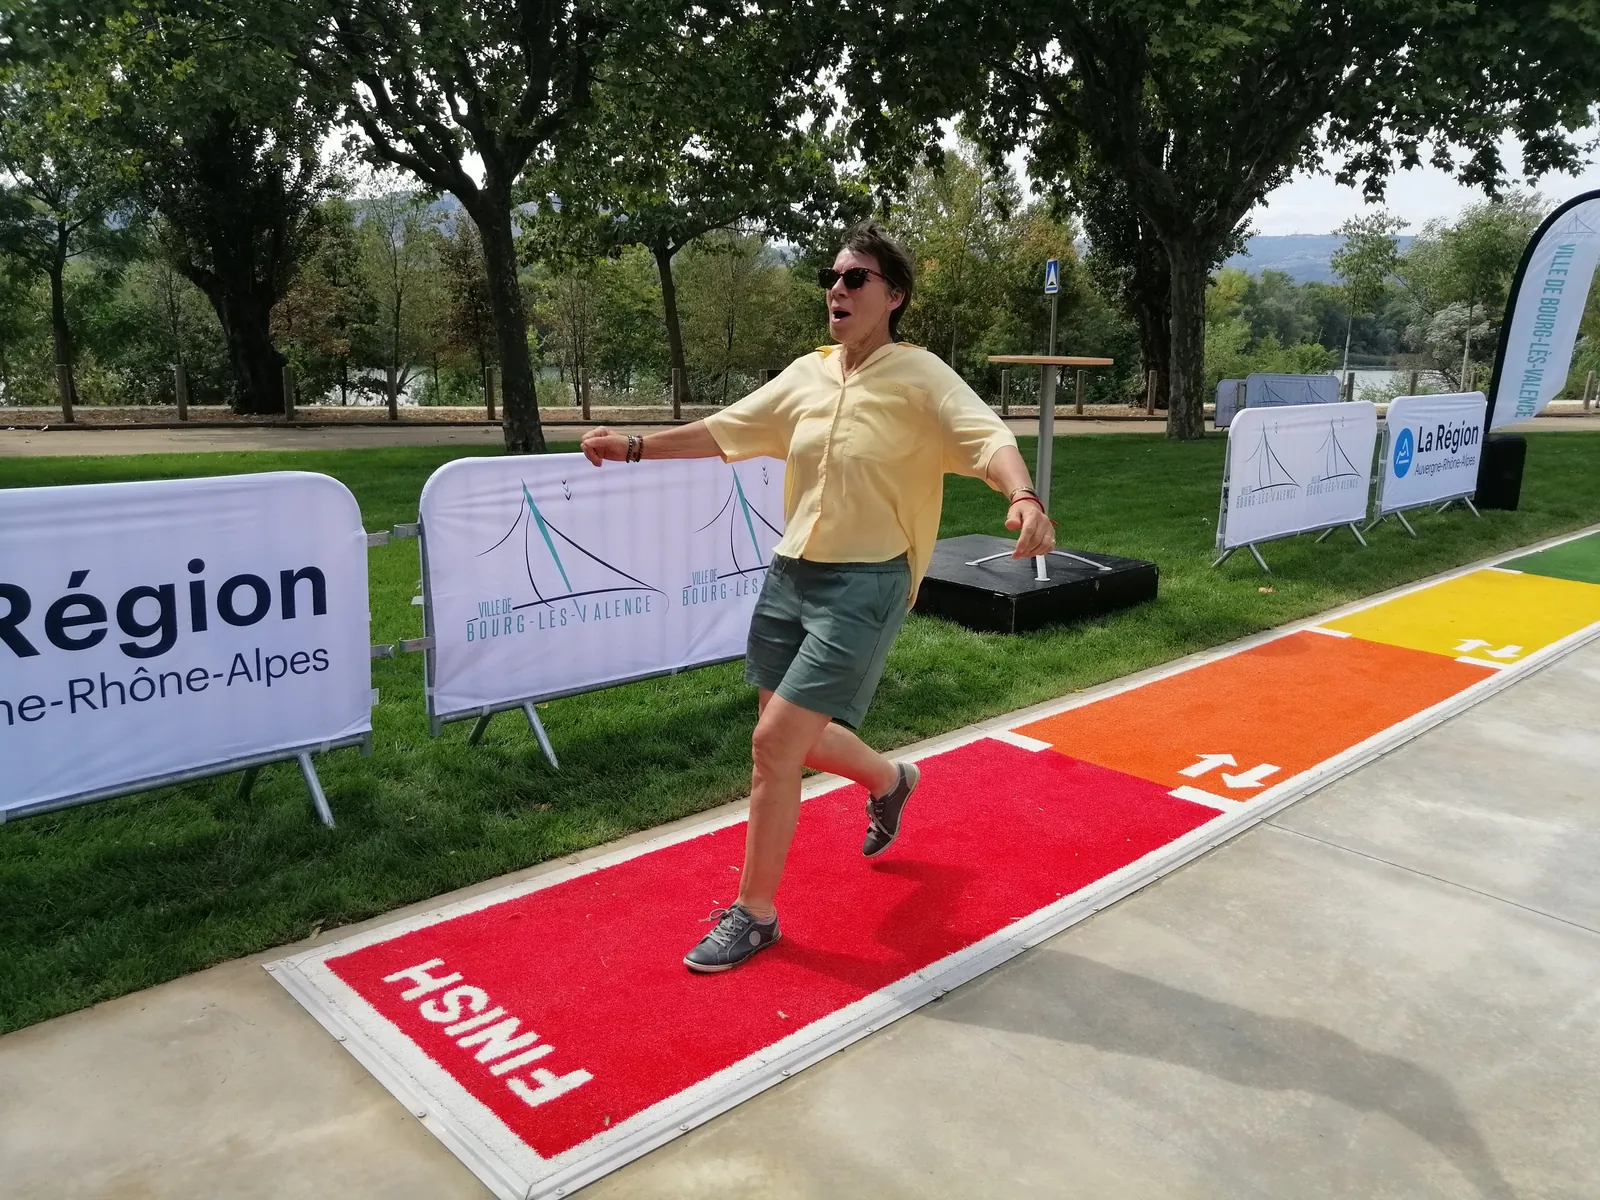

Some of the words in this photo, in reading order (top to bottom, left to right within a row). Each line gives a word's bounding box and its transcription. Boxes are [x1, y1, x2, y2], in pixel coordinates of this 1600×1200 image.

[1548, 243, 1576, 276] VILLE
[1543, 279, 1565, 295] DE
[1515, 297, 1560, 418] BOURG-LÈS-VALENCE
[1417, 426, 1433, 453] La
[1435, 420, 1479, 454] Région
[1414, 454, 1476, 476] Auvergne-Rhône-Alpes
[692, 569, 709, 586] VILLE
[710, 568, 717, 583] DE
[0, 558, 327, 658] Région
[478, 599, 500, 618] VILLE
[502, 598, 512, 615] DE
[383, 957, 594, 1107] FINISH
